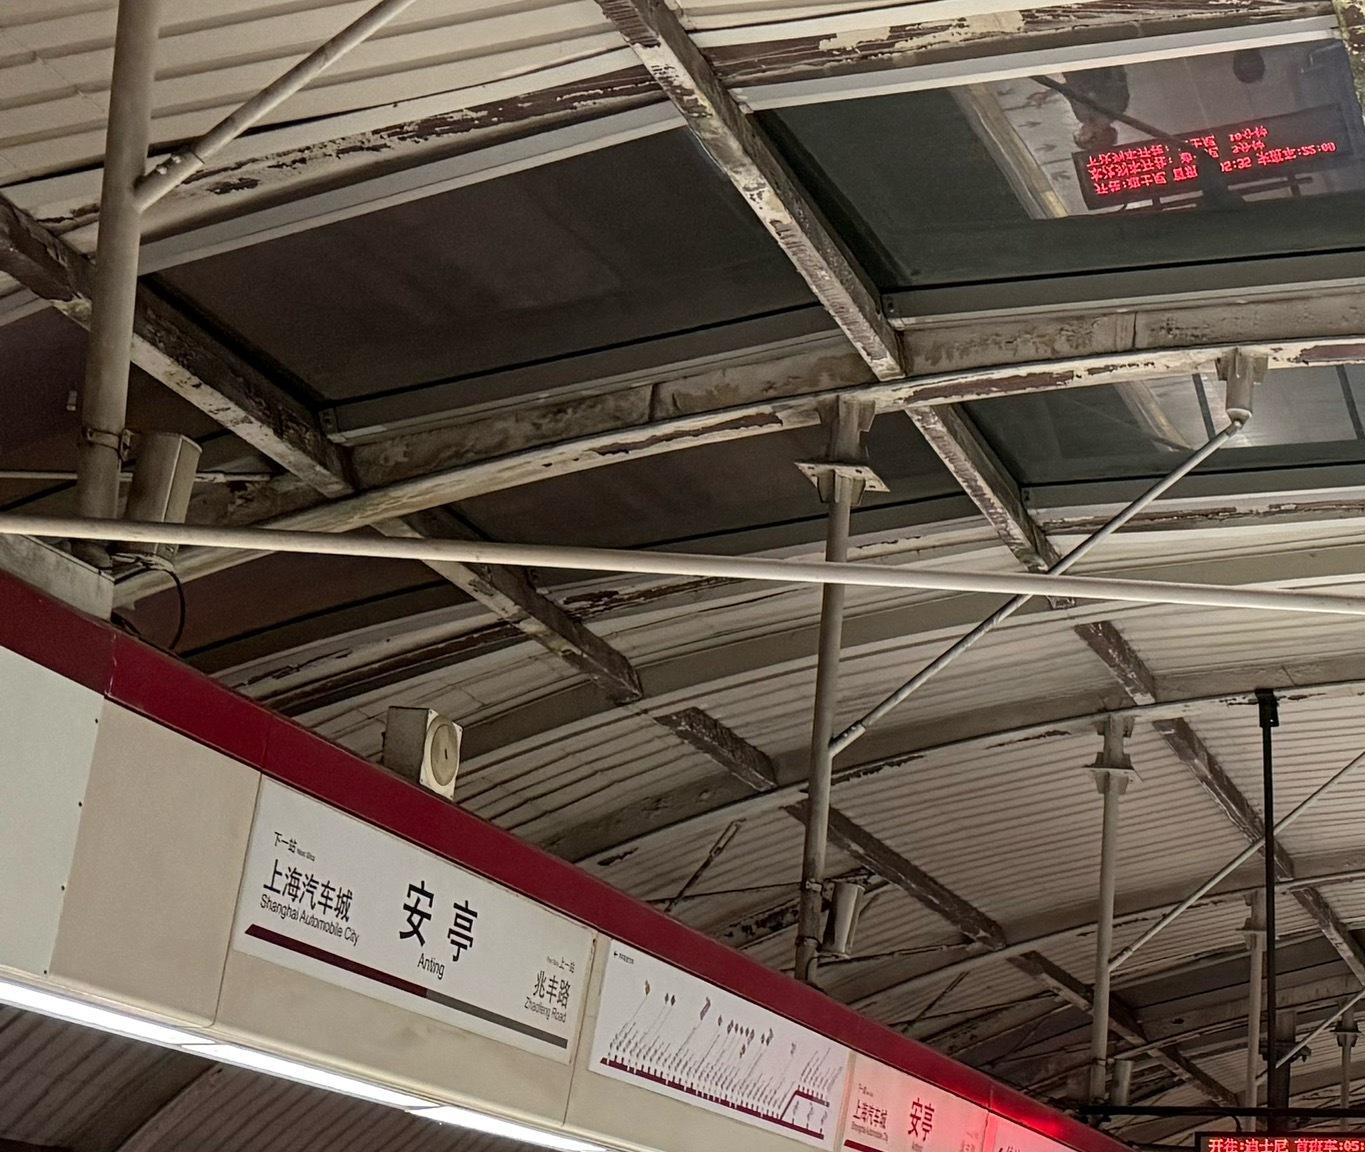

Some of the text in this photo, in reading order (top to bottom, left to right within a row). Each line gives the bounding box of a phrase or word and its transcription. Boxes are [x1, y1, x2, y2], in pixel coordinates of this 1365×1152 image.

[274, 831, 297, 854] 下一站
[263, 859, 353, 922] 上海汽车城
[260, 893, 360, 947] Shanghai Automobile City
[399, 880, 478, 962] 安亭
[418, 953, 445, 981] Anting
[532, 970, 571, 1009] 兆丰路
[908, 1097, 935, 1142] 安亭
